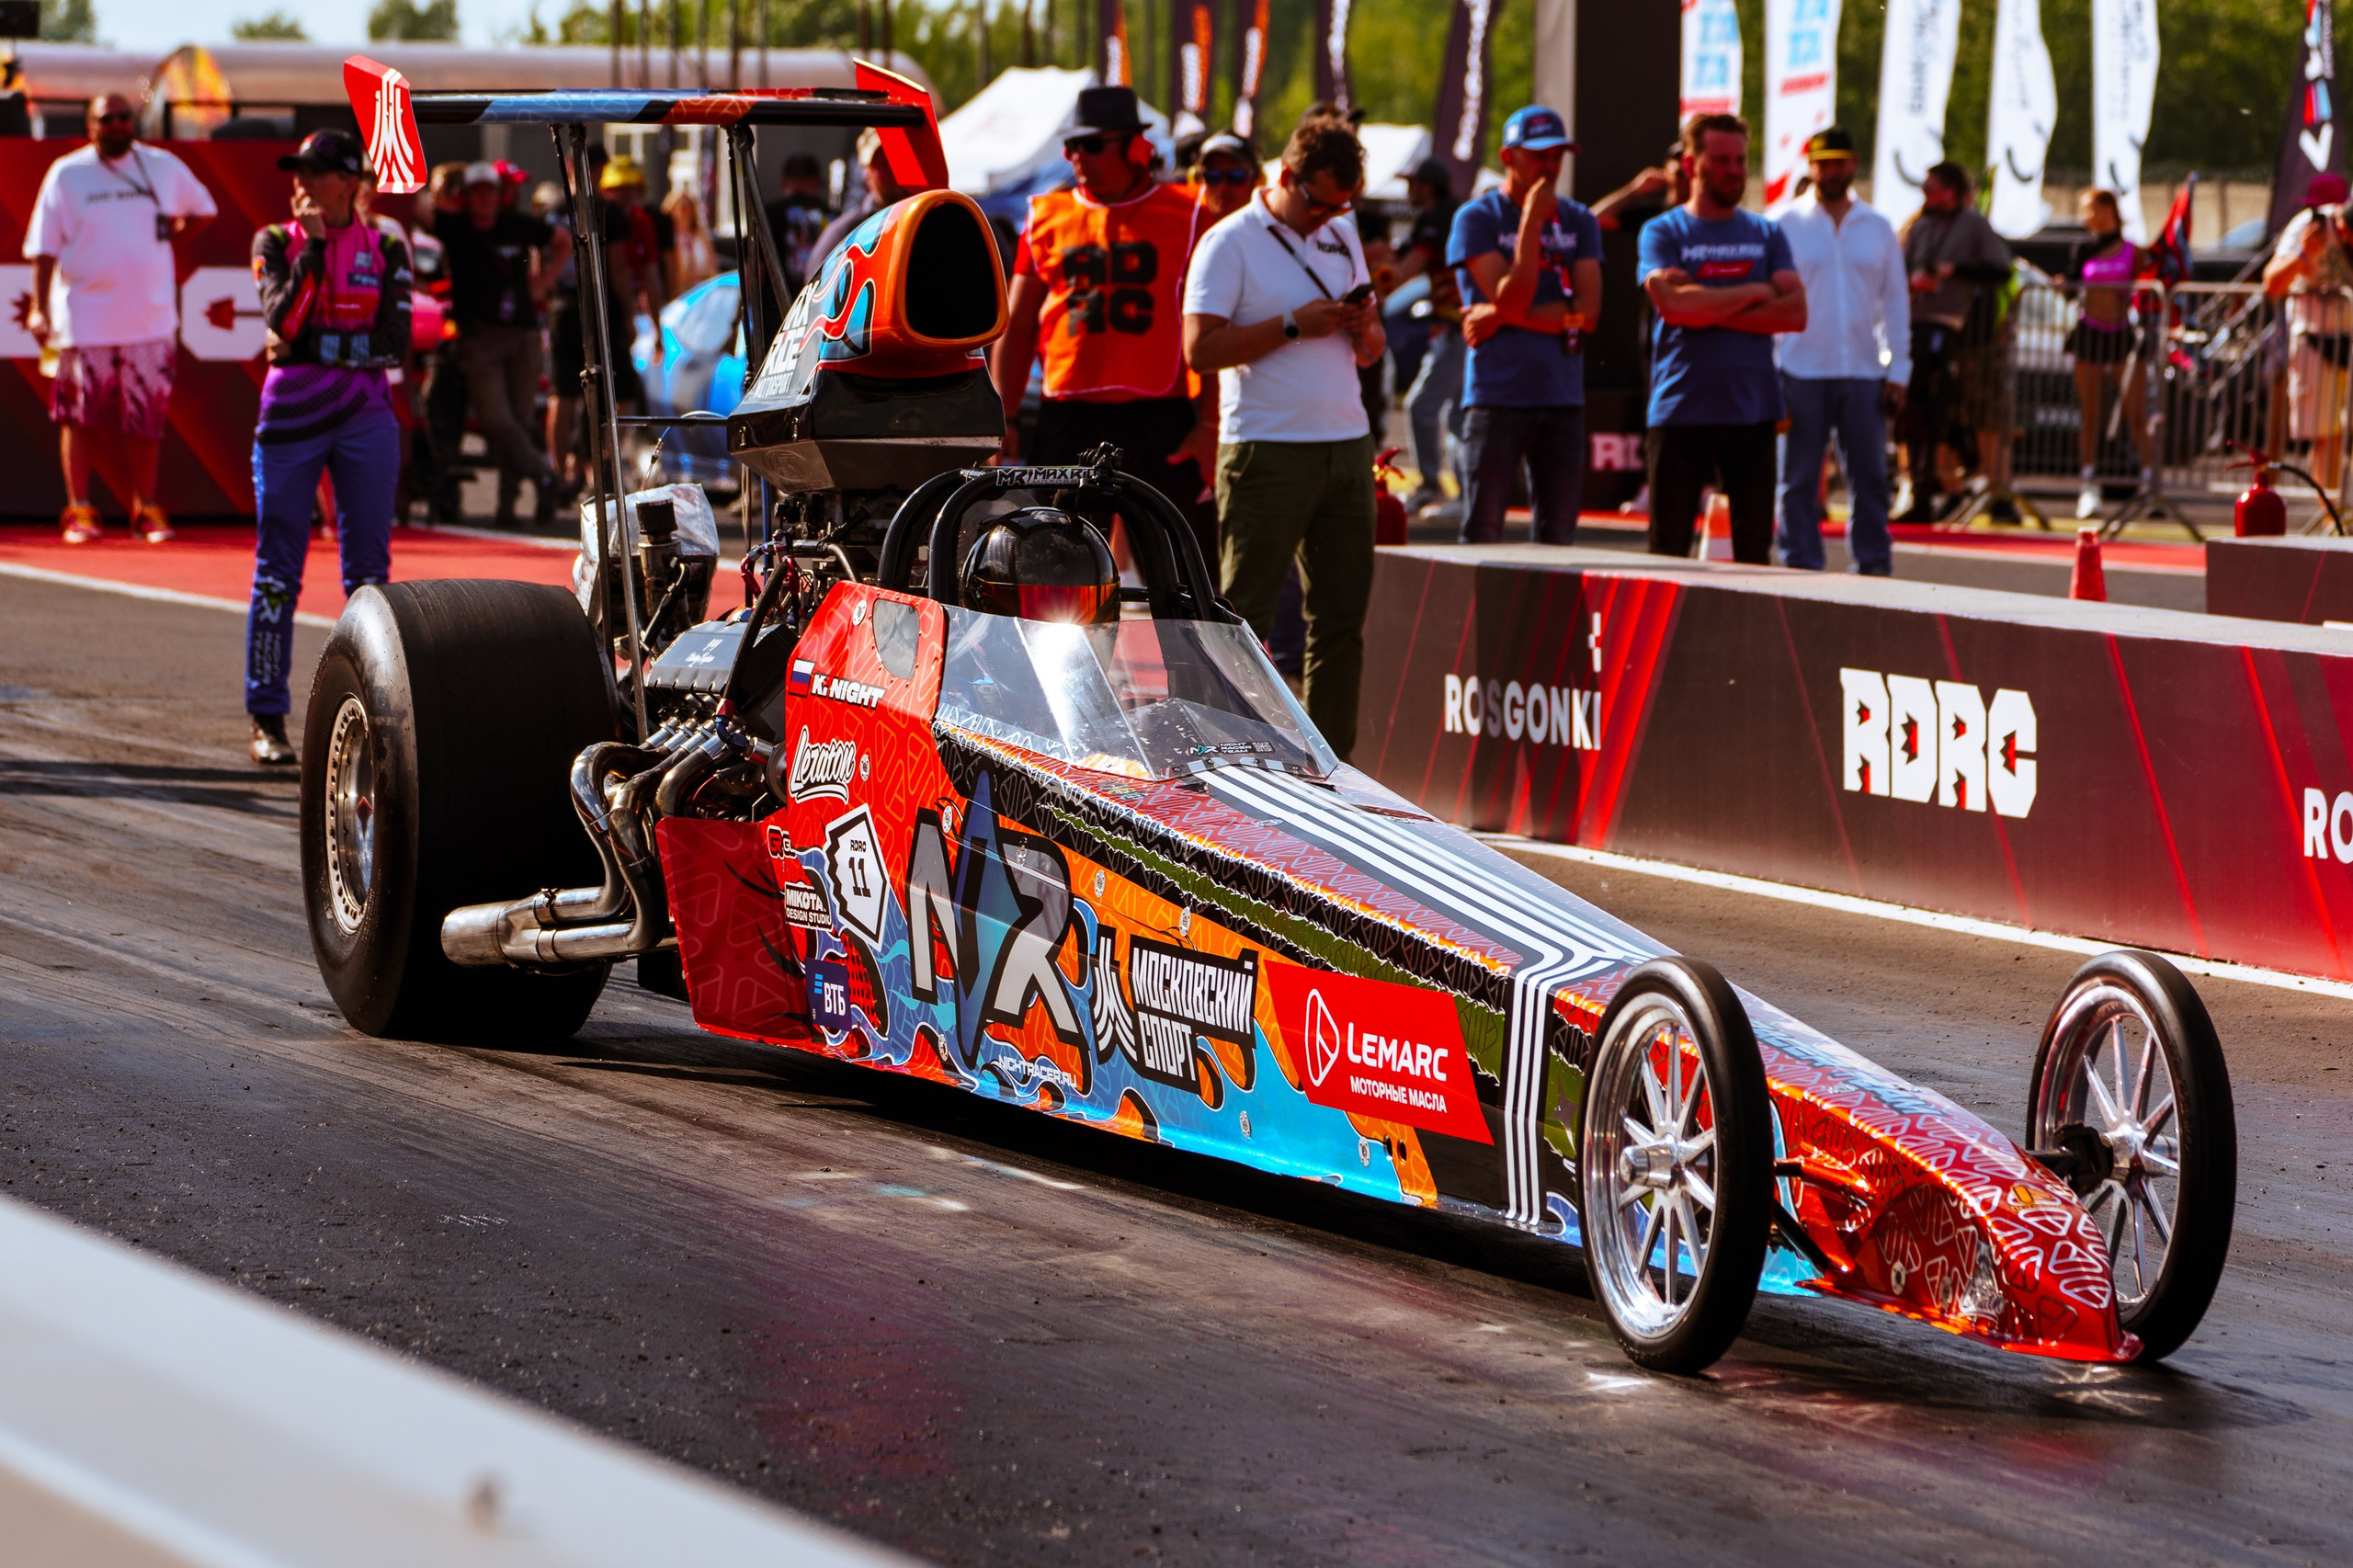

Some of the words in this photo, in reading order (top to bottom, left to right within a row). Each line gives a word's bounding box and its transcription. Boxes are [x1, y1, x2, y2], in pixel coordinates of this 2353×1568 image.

[829, 677, 886, 709] NIGHT
[1445, 674, 1601, 751] ROSGONKI
[1840, 667, 2037, 819] RDRC
[849, 839, 867, 853] RDRC
[848, 856, 872, 898] 11
[786, 907, 808, 922] DESIGN
[808, 911, 832, 926] STUDIO
[824, 982, 847, 1017] ВТБ
[1131, 947, 1254, 1035] МОСКОВСКИЙ
[1137, 1011, 1197, 1082] СПОРТ
[998, 1054, 1077, 1088] NIGHTRACER.RU
[1349, 1075, 1408, 1105] МОТОРНЫЕ
[1408, 1088, 1448, 1114] МАСЛА
